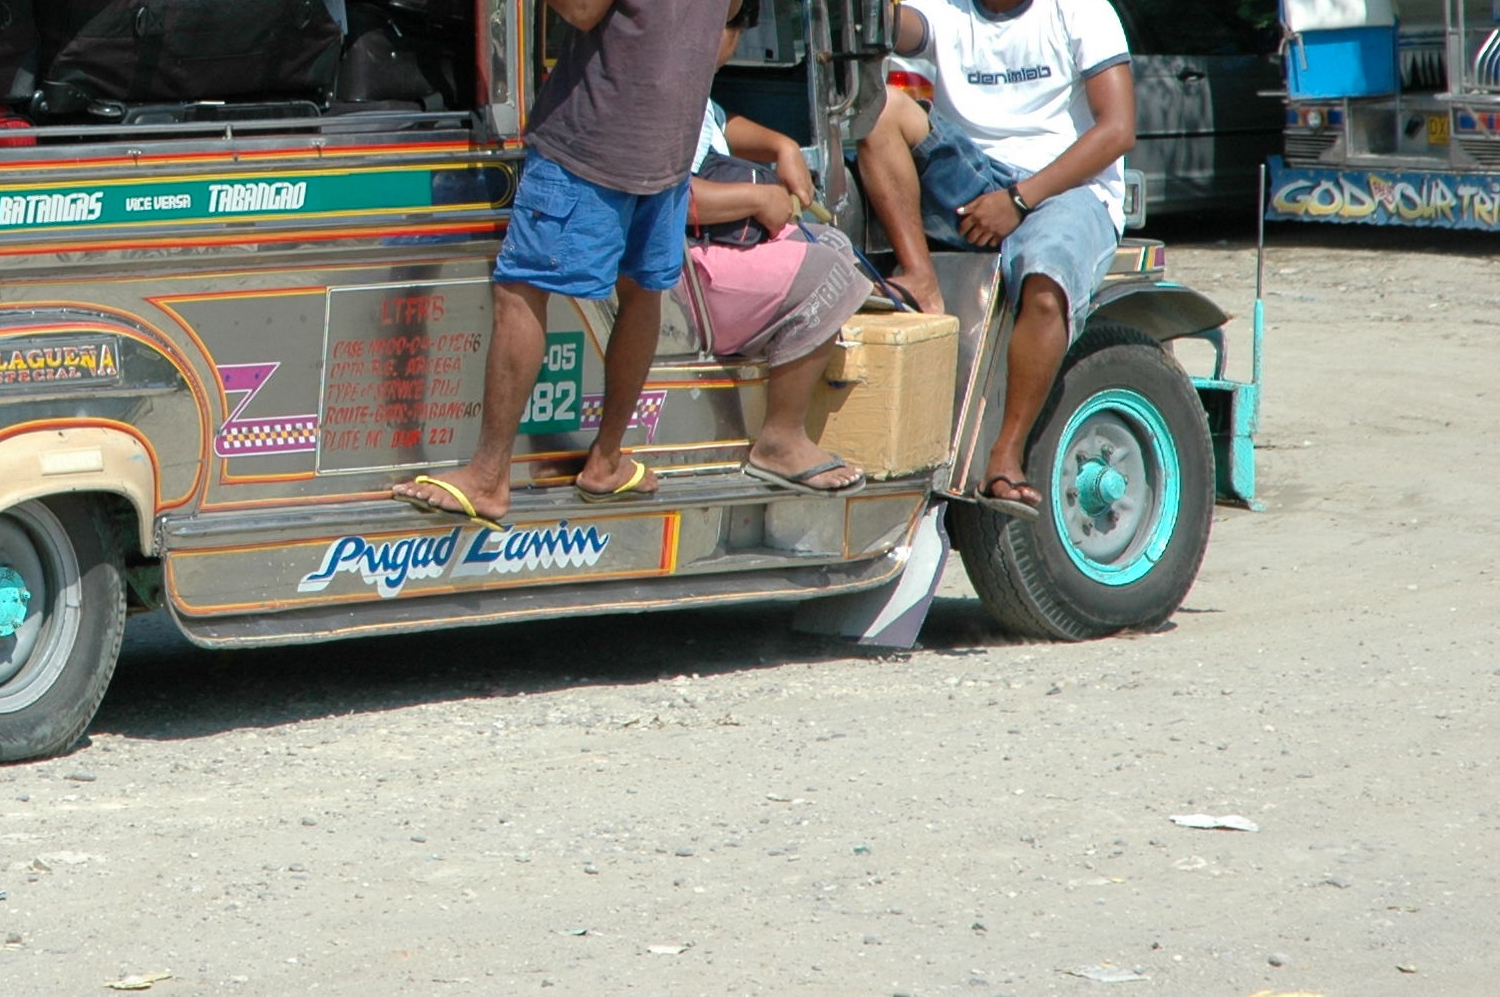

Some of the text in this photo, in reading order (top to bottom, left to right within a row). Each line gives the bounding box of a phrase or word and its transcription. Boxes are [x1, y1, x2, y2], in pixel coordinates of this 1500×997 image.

[126, 197, 152, 211] VICE
[154, 195, 191, 210] VERSA
[208, 182, 307, 213] TABANGAO
[1274, 176, 1376, 218] GOD
[429, 428, 454, 445] 221
[298, 526, 462, 597] Pugad
